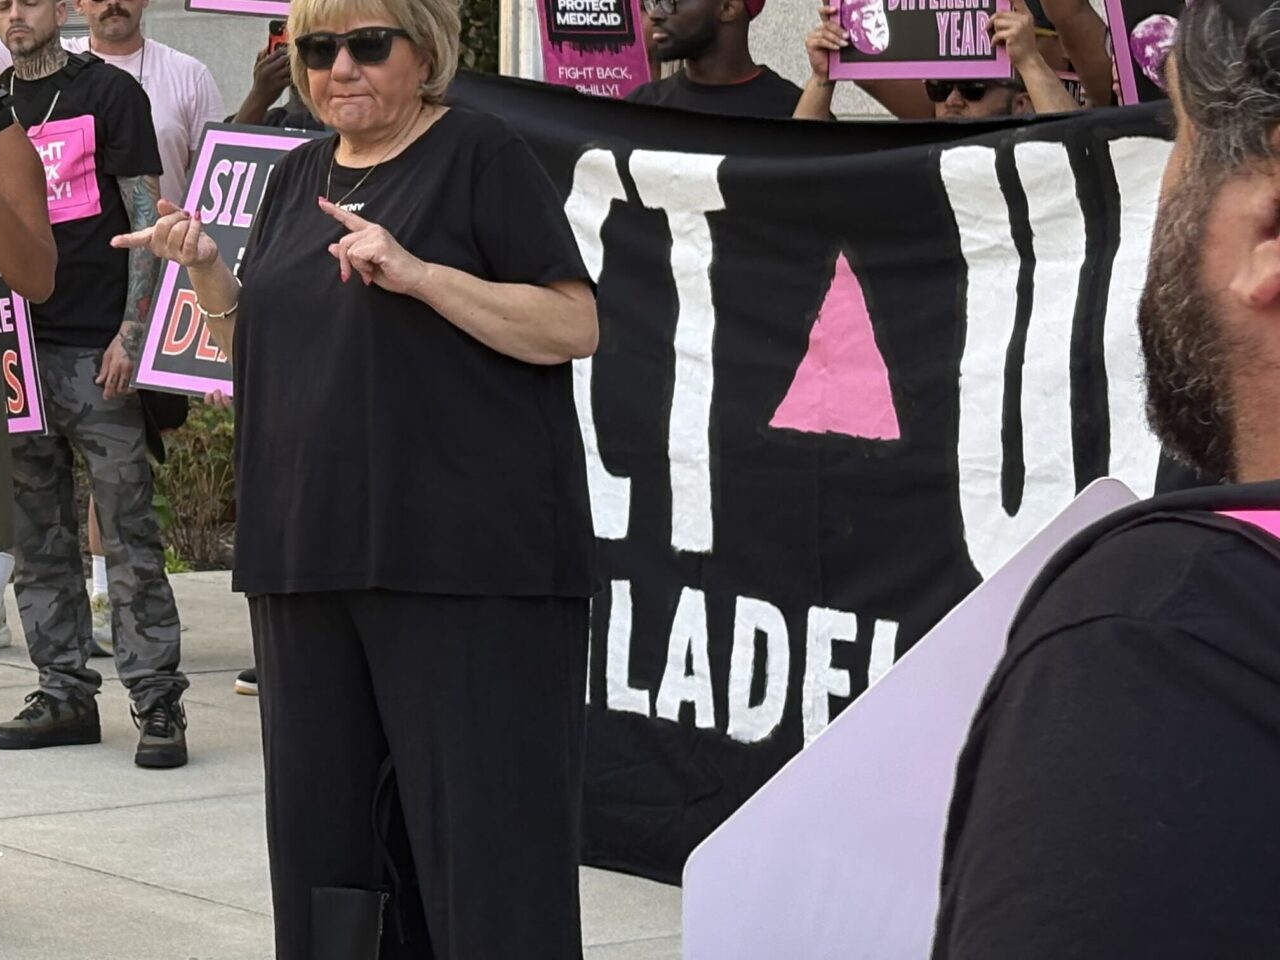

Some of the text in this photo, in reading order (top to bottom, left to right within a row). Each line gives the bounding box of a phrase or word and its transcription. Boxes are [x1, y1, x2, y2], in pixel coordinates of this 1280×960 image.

[557, 12, 621, 25] MEDICAID
[936, 9, 991, 57] YEAR
[558, 67, 632, 80] FIGHT BACK,
